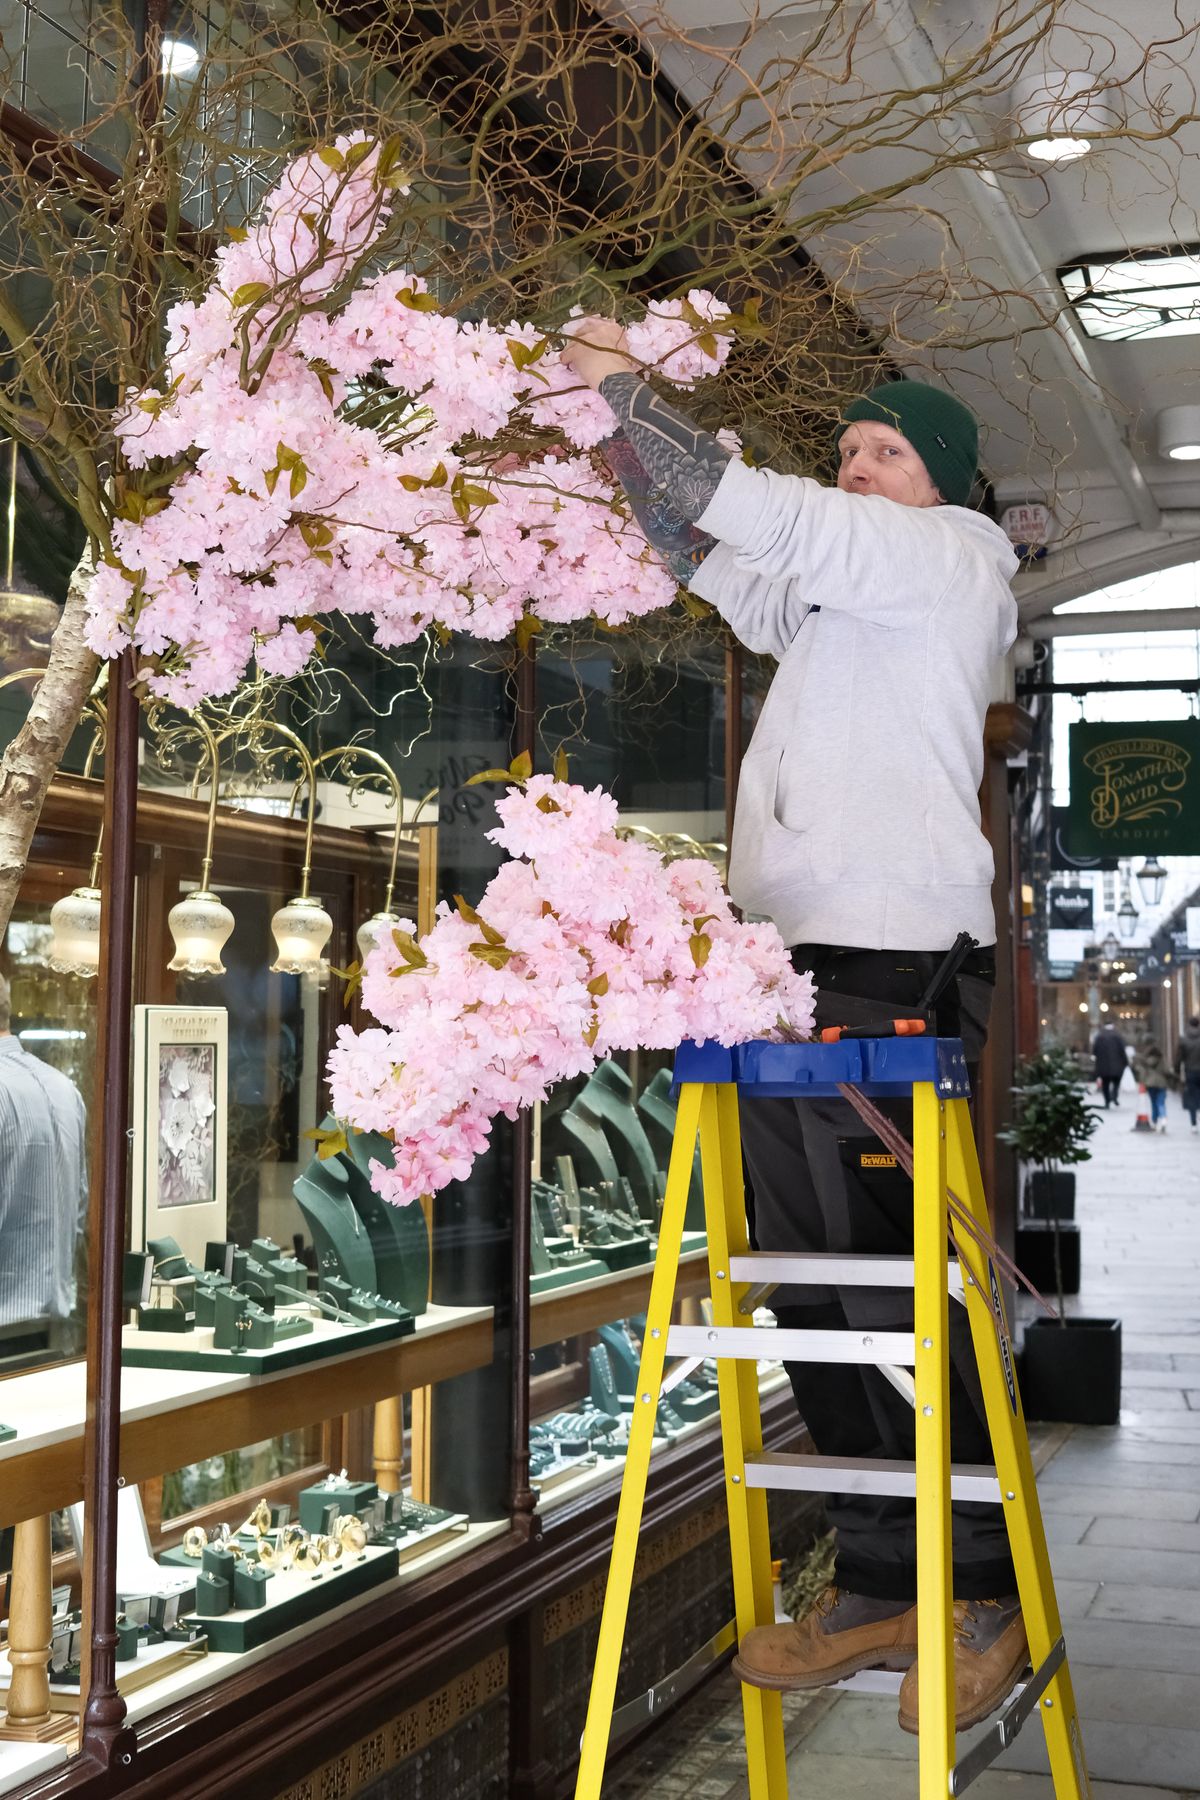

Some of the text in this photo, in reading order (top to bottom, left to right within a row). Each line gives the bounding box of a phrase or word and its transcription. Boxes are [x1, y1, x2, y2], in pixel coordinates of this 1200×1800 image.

[1094, 741, 1179, 760] JEWELLERY BY
[1094, 759, 1184, 800] JONATHAN
[1091, 785, 1158, 828] DAVID
[1100, 829, 1170, 839] CARDIFF
[993, 1289, 1015, 1387] WENER
